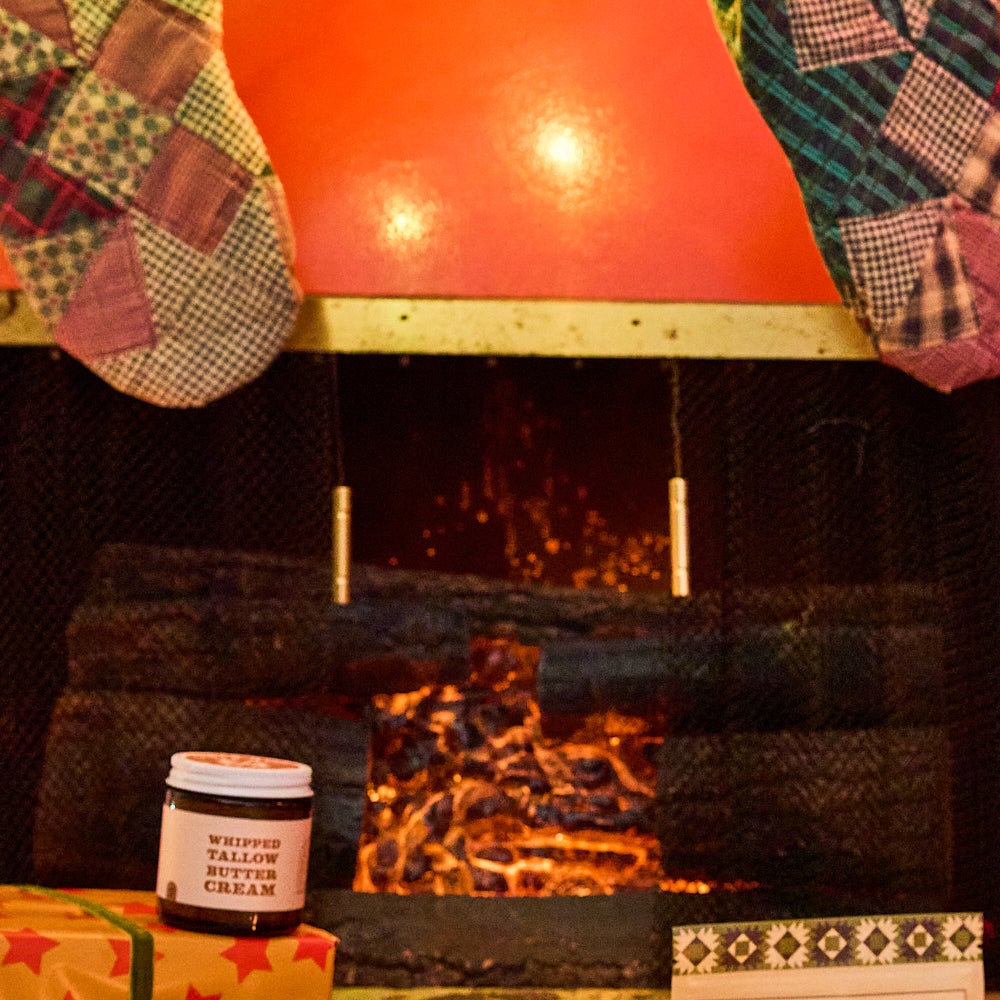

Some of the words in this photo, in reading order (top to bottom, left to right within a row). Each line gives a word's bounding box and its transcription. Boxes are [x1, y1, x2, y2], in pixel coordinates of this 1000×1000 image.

[209, 834, 281, 849] WHIPPED
[207, 849, 279, 864] TALLOW
[206, 865, 277, 880] BUTTER
[204, 880, 276, 896] CREAM
